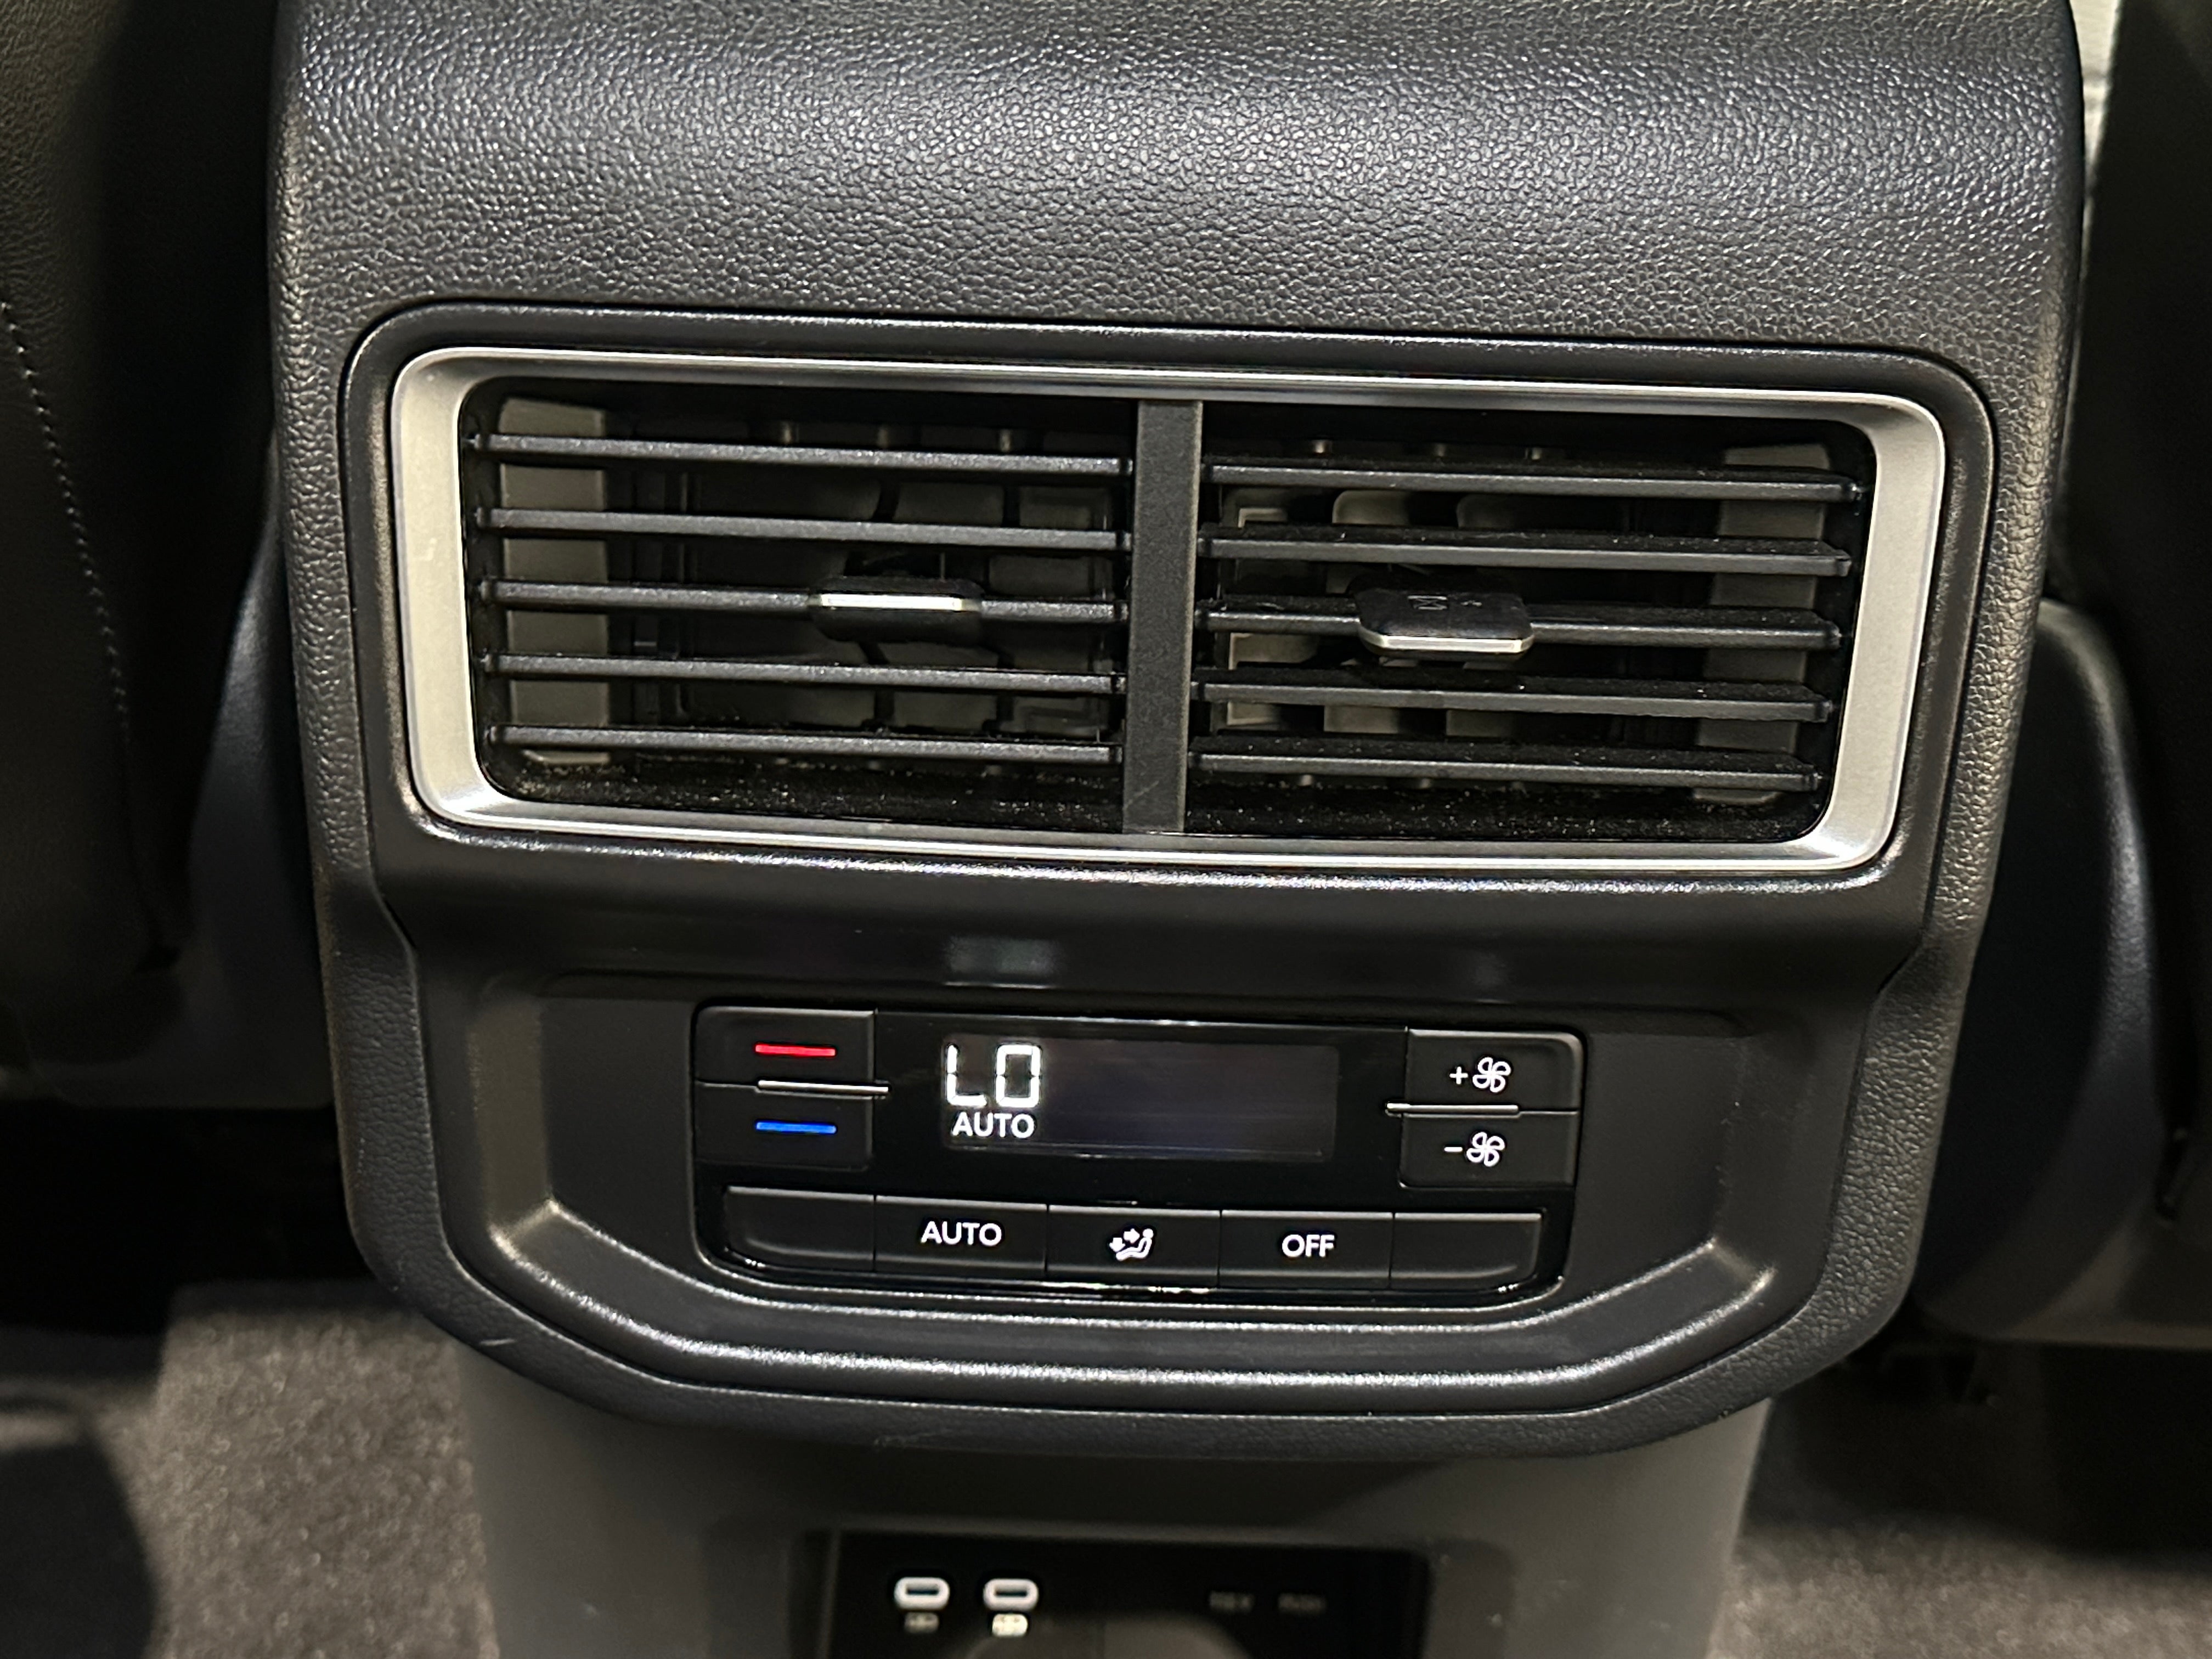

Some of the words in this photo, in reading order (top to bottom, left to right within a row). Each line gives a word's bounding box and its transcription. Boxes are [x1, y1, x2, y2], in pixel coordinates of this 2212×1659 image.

[951, 1111, 1035, 1138] AUTO
[920, 1220, 1002, 1247] AUTO
[1282, 1234, 1335, 1257] OFF
